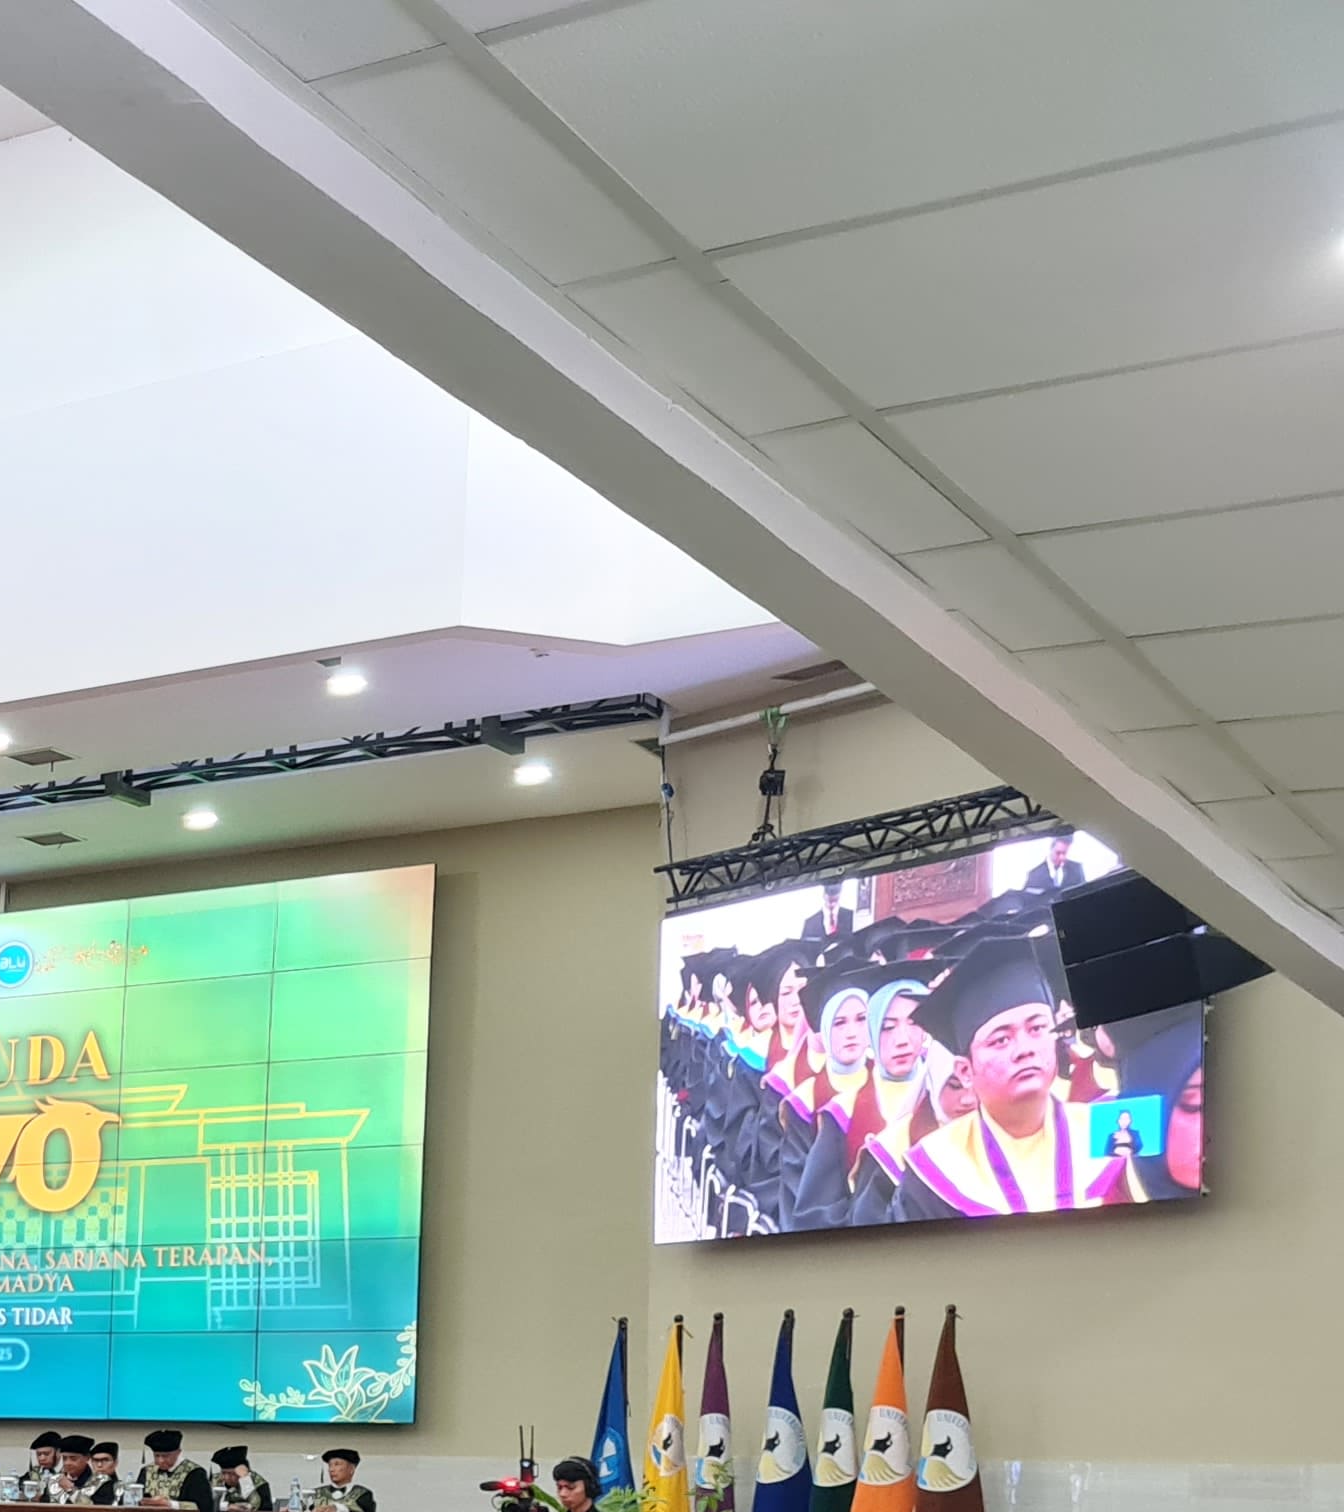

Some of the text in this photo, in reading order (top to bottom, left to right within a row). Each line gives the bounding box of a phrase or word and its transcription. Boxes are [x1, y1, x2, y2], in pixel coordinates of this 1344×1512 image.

[45, 1249, 146, 1271] SARJANA
[153, 1244, 273, 1267] TERAPAN,
[12, 1307, 73, 1326] TIDAR
